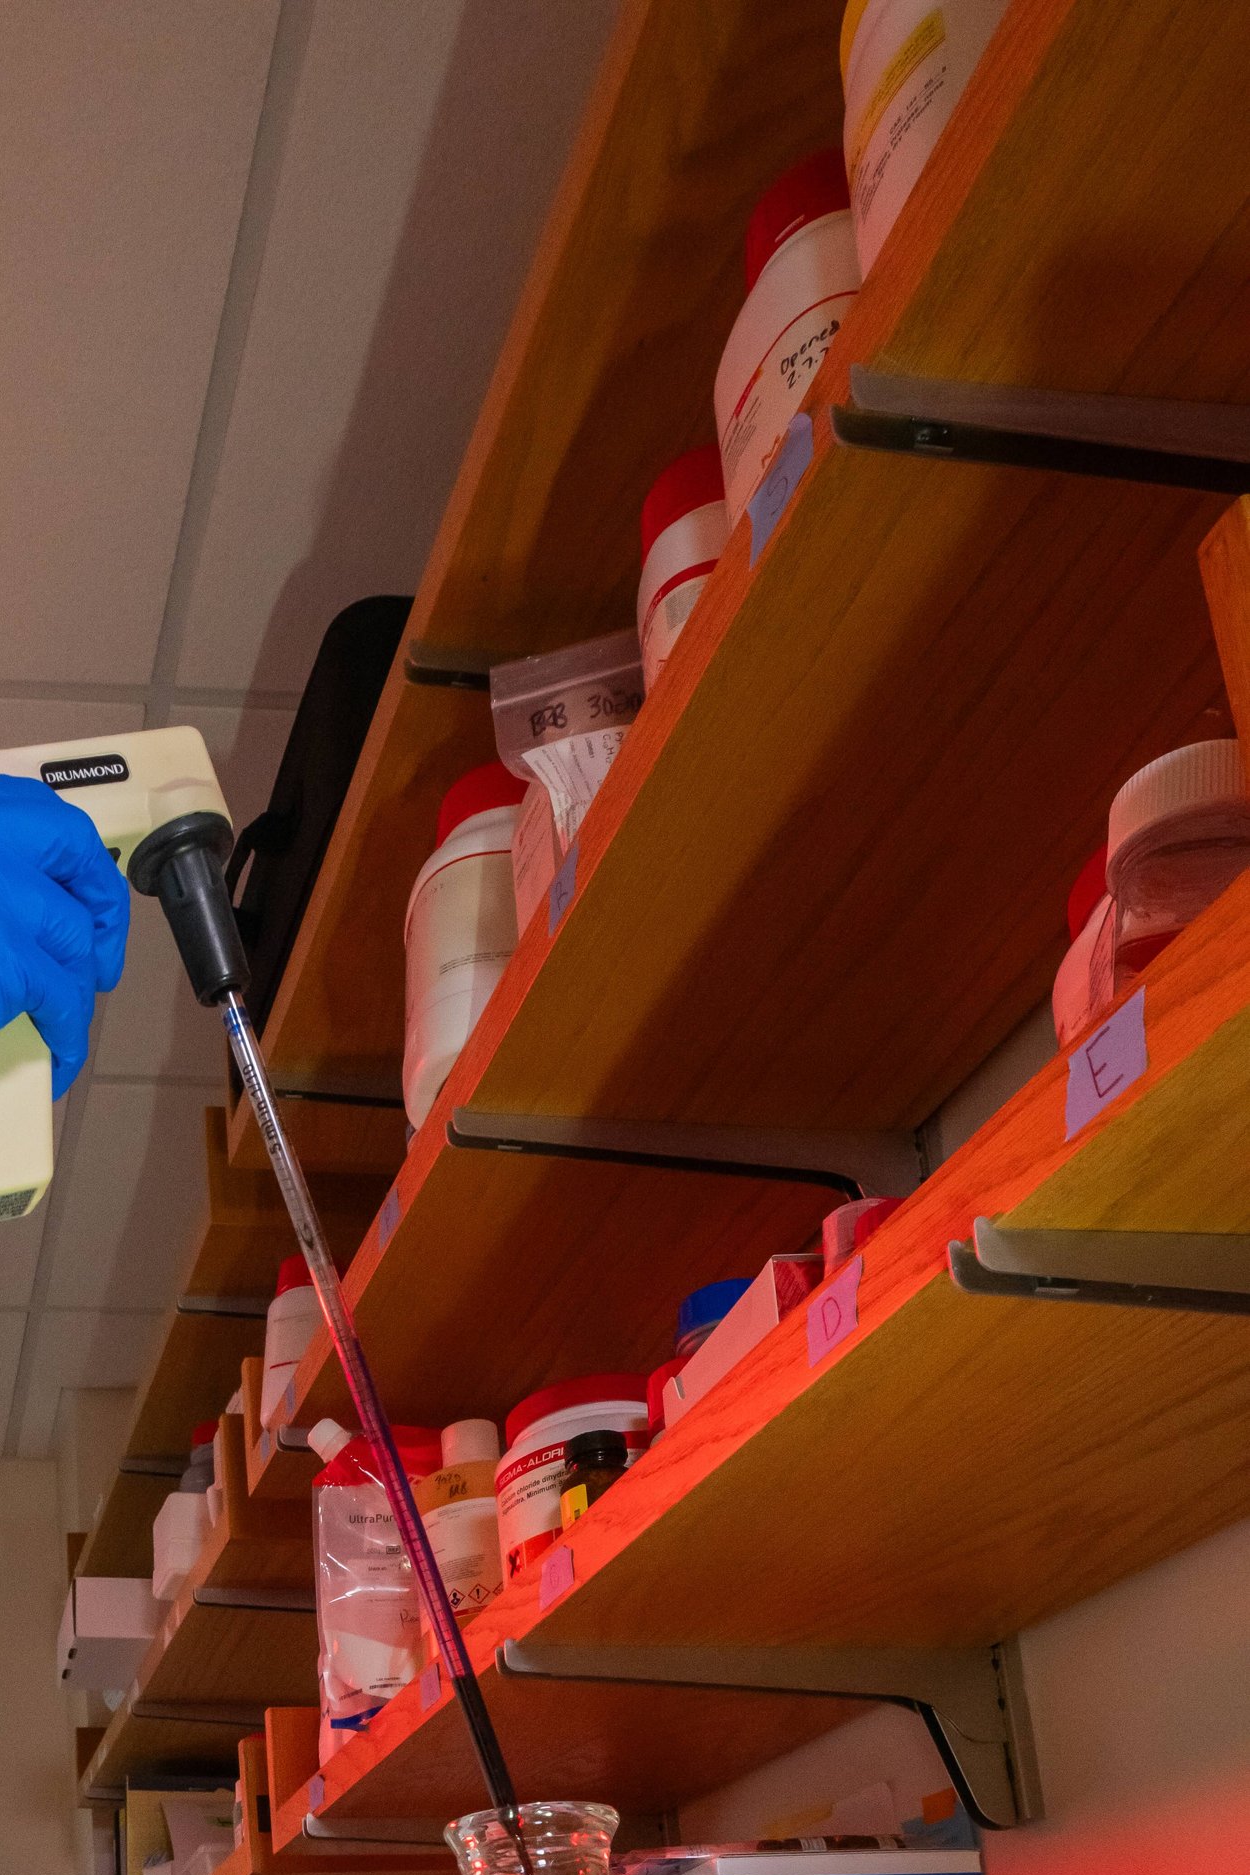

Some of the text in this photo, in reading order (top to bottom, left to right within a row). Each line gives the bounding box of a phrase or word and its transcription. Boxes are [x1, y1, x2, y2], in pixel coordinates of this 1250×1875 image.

[780, 319, 841, 376] Opened
[45, 763, 125, 784] DRUMMOND
[1085, 1025, 1125, 1099] E
